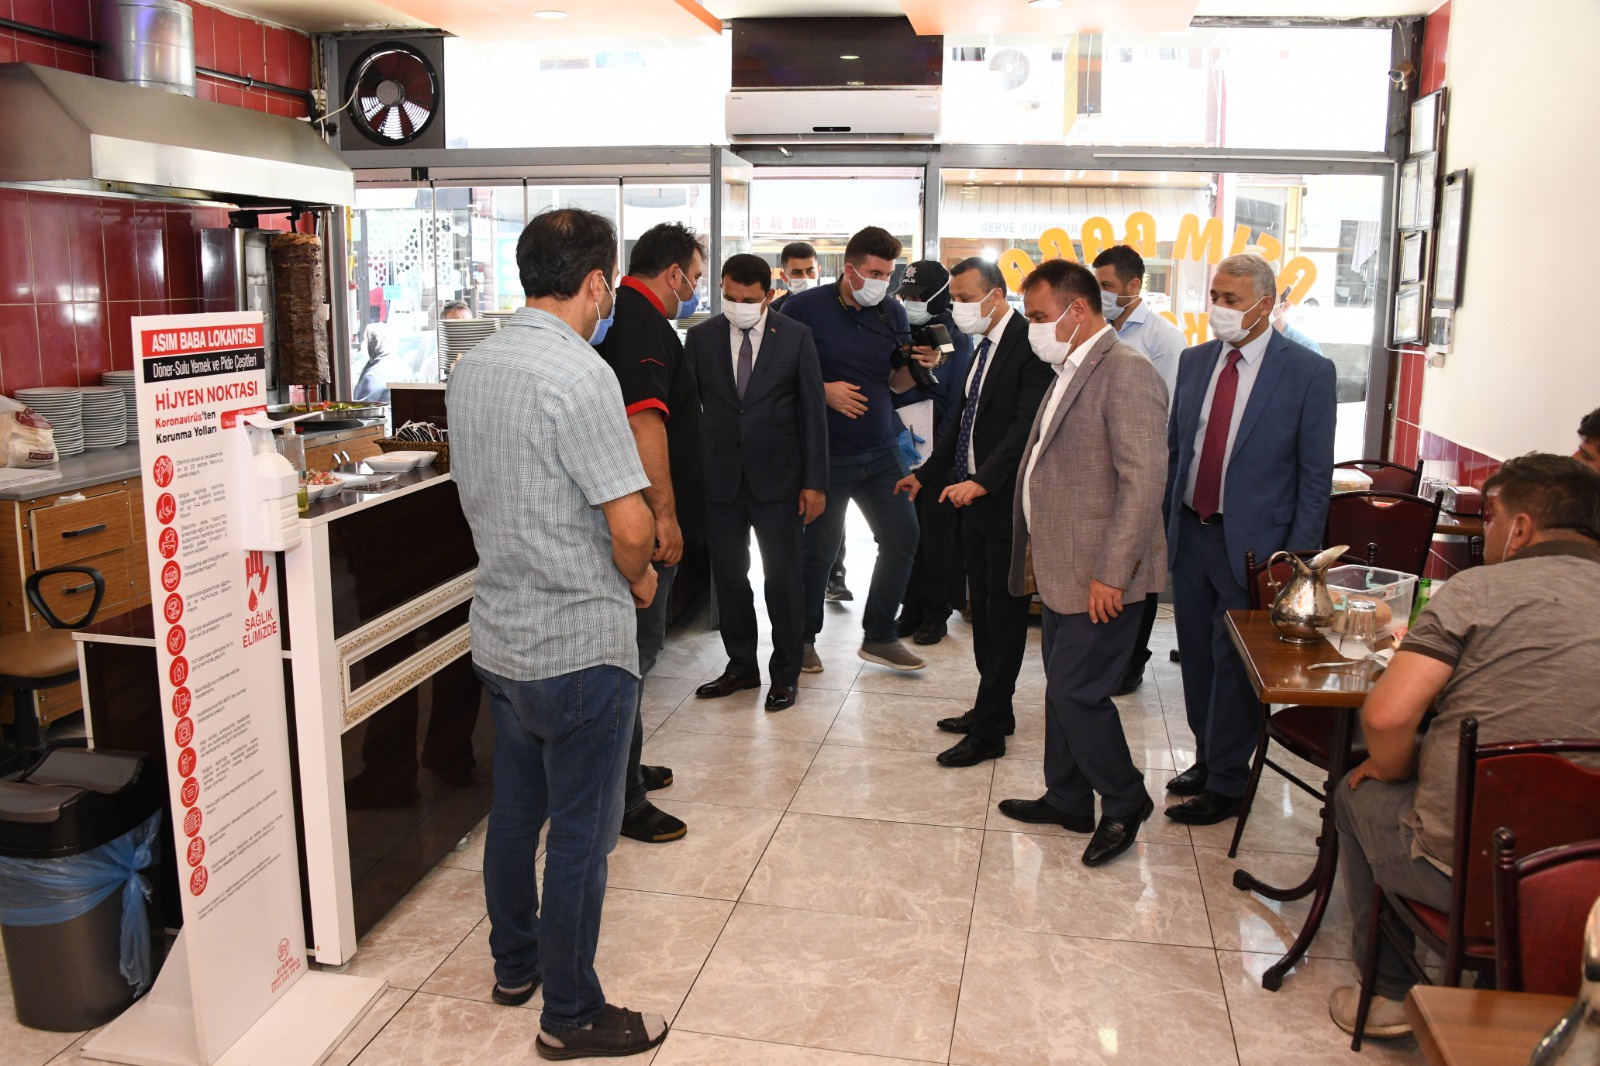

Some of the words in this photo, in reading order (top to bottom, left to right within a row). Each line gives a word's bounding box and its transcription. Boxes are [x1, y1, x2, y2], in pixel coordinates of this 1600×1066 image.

[770, 217, 783, 230] AV
[980, 222, 1015, 233] MERVE
[152, 333, 178, 352] ASIM
[180, 332, 206, 350] BABA
[208, 328, 256, 347] LOKANTASI
[153, 361, 190, 378] Döner-Sulu
[190, 358, 212, 374] Yemek
[212, 360, 220, 371] ve
[220, 355, 233, 370] Pide
[234, 353, 257, 372] Çeşitleri
[155, 388, 204, 411] HİJYEN
[207, 381, 258, 404] NOKTASI
[155, 411, 216, 428] Koronavirüs'ten
[156, 430, 192, 444] Korunma
[194, 425, 217, 437] Yolları
[245, 608, 274, 632] SAĞLIK
